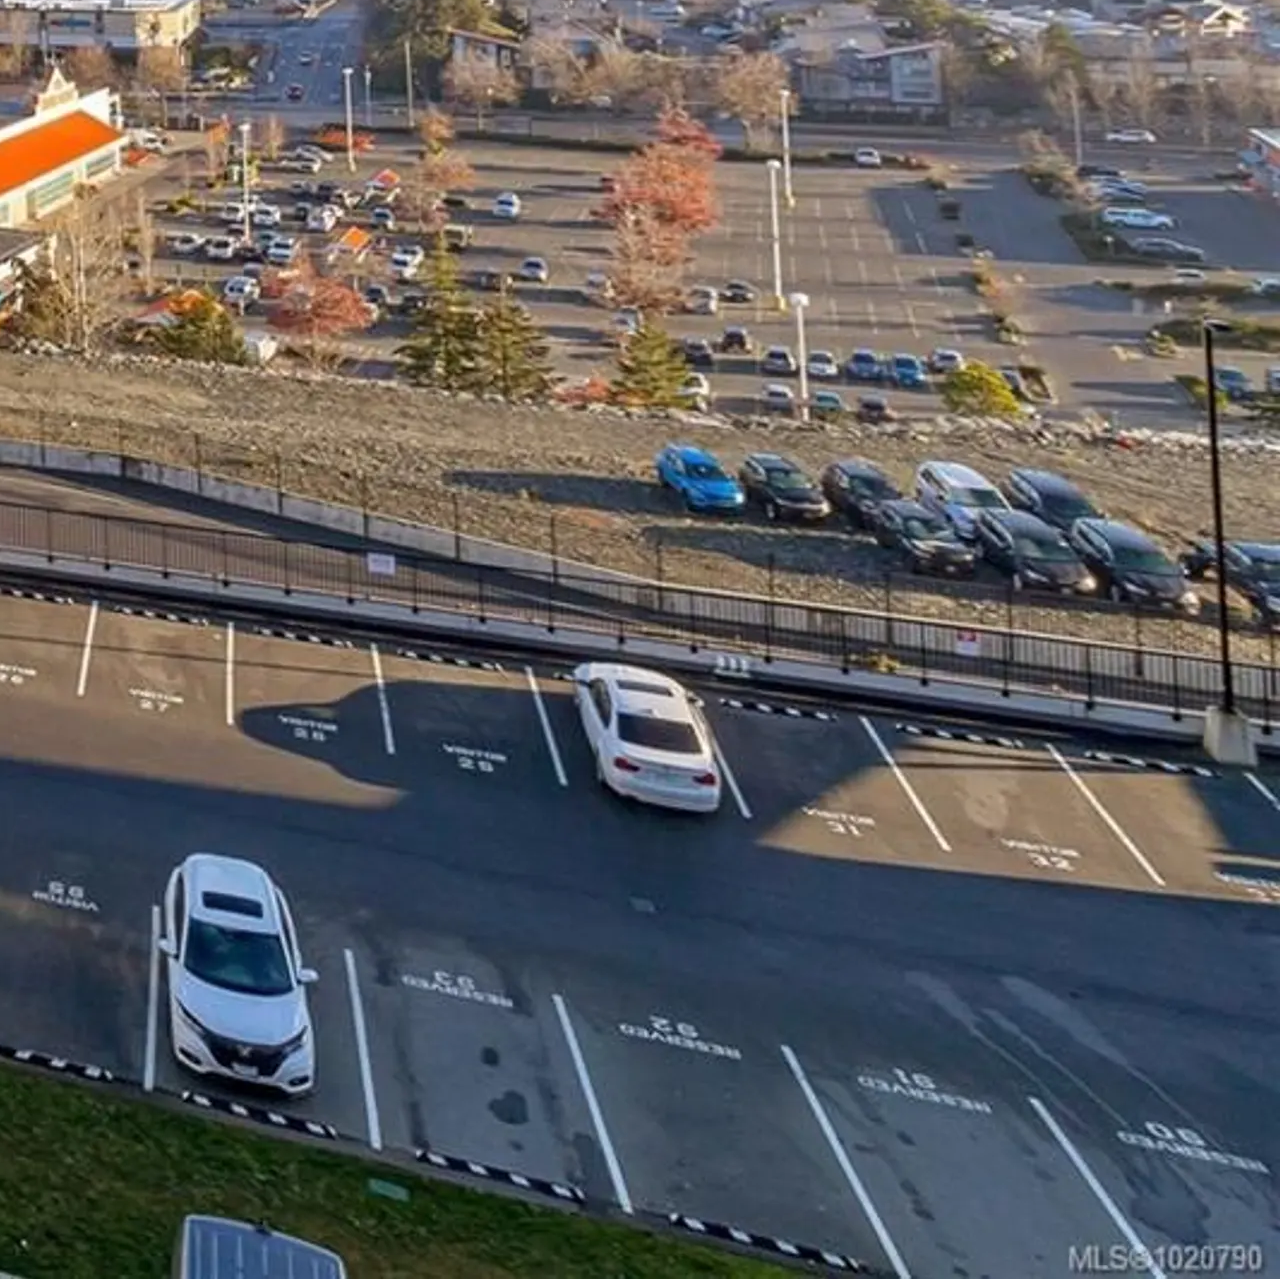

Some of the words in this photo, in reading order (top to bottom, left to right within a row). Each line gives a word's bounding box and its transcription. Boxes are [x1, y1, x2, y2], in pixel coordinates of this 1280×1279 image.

[442, 743, 507, 763] VISITOR
[801, 806, 876, 827] VISITOR
[826, 821, 862, 837] 31
[1000, 837, 1080, 858] VISITOR
[1027, 852, 1075, 872] 32
[32, 890, 100, 912] VISITOR
[401, 974, 513, 1008] RESERVED
[434, 971, 475, 992] 93
[649, 1015, 699, 1038] 92
[619, 1023, 742, 1060] RESERVED
[893, 1066, 936, 1089] 91
[857, 1075, 992, 1114] RESERVED
[1144, 1121, 1205, 1146] 90
[1117, 1130, 1271, 1174] RESERVED
